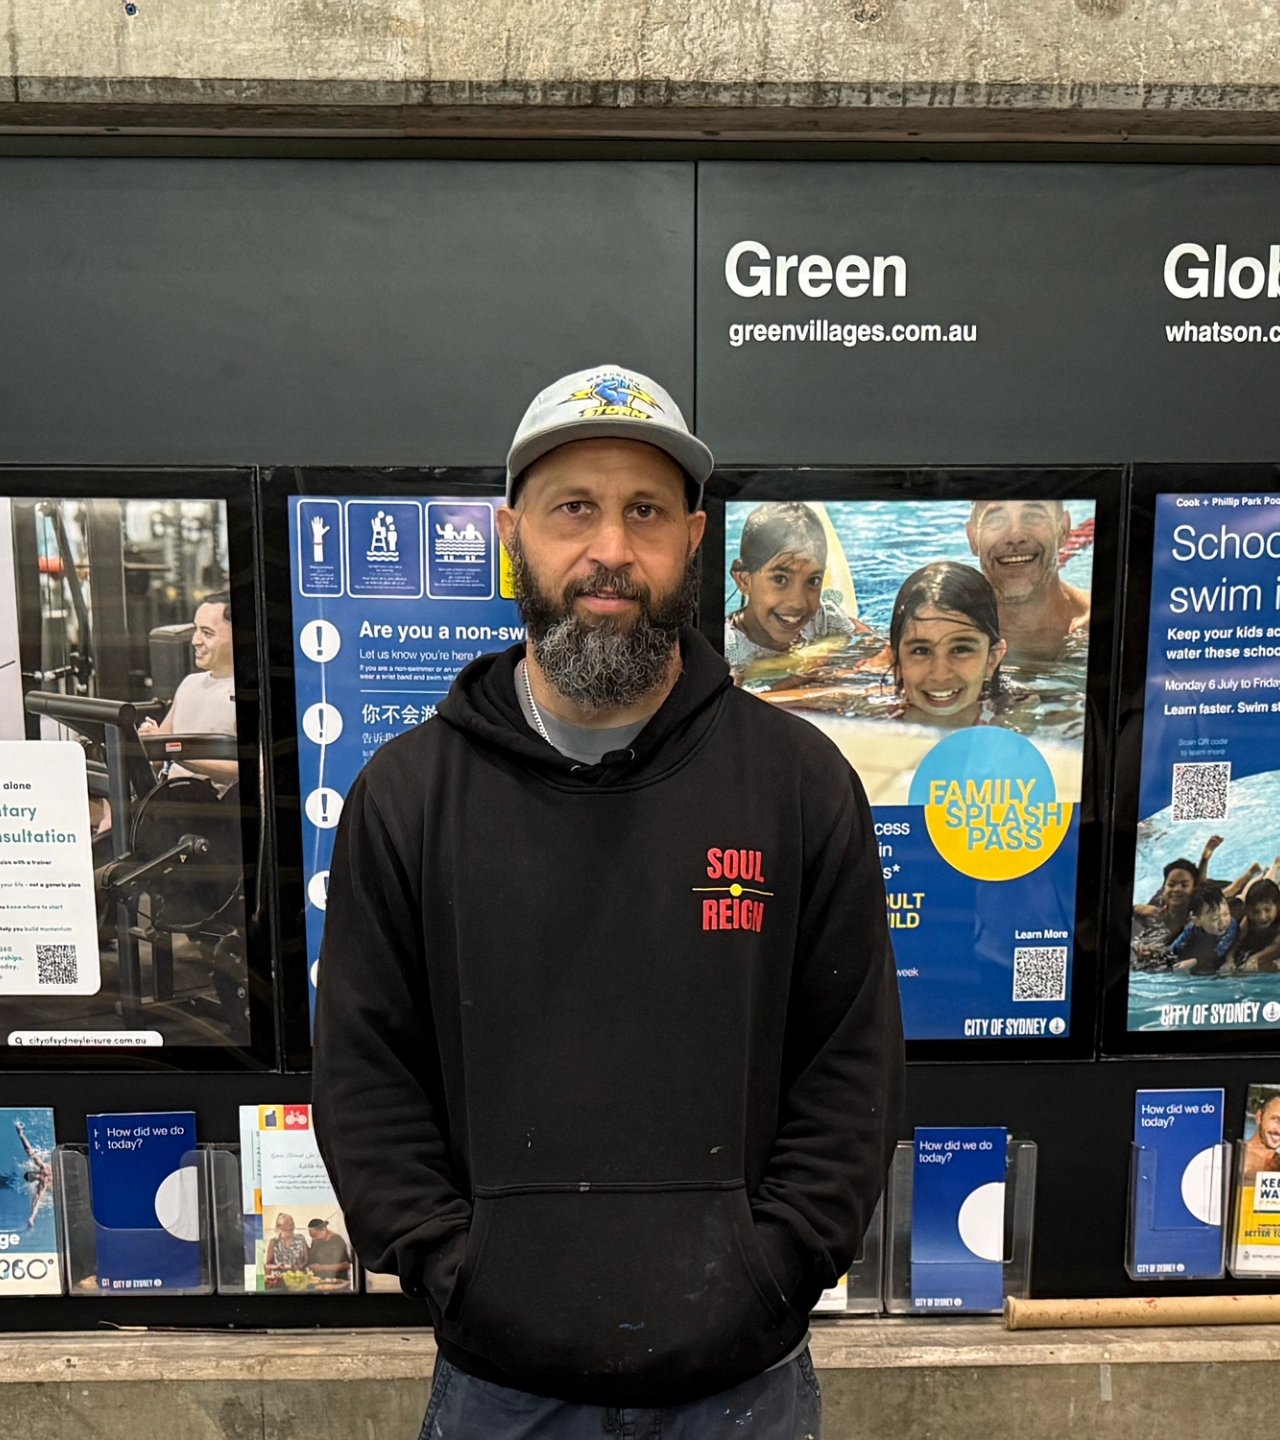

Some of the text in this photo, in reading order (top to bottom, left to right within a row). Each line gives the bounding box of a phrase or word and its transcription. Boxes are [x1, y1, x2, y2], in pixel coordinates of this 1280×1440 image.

[725, 240, 906, 297] Green
[729, 319, 977, 346] greenvillages.com.au
[580, 406, 651, 419] STORM
[1169, 577, 1261, 613] swim
[360, 620, 392, 637] Are
[398, 625, 434, 642] you
[439, 626, 450, 638] a
[1165, 678, 1206, 692] Monday
[1208, 679, 1216, 689] 6
[1218, 677, 1238, 691] July
[1241, 678, 1250, 688] to
[4, 781, 31, 790] alone
[929, 779, 1036, 806] FAMILY
[945, 803, 1062, 829] SPLASH
[967, 826, 1043, 851] PASS
[707, 848, 764, 882] SOUL
[703, 899, 764, 932] REIGN
[1015, 929, 1068, 939] Learn More
[965, 1018, 1046, 1035] CITY OF SYDNEY
[107, 1125, 184, 1137] How did we do
[107, 1139, 142, 1151] today?
